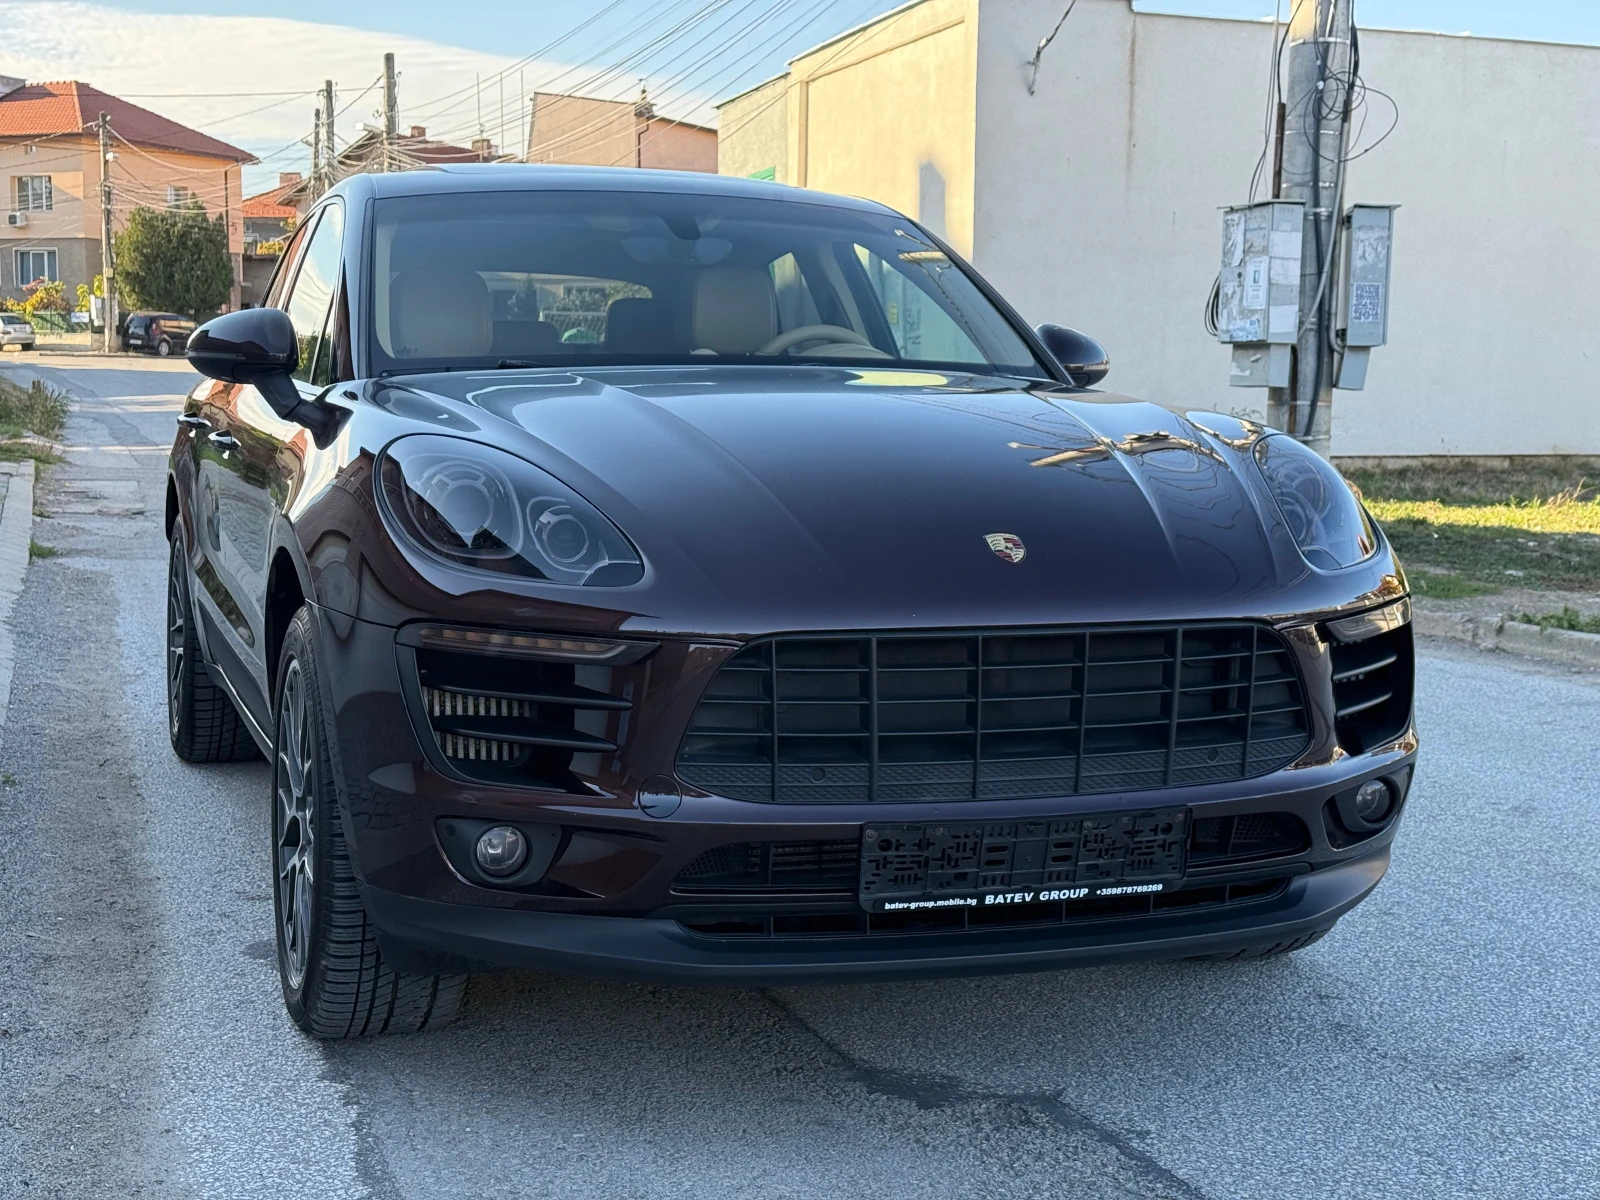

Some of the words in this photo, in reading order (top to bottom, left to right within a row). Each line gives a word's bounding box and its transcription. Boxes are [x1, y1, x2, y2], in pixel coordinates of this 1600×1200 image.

[885, 898, 977, 910] batev-group.mobile.bg
[985, 893, 1034, 904] BATEV
[1040, 888, 1089, 901] GROUP
[1096, 884, 1163, 896] +359878769269
